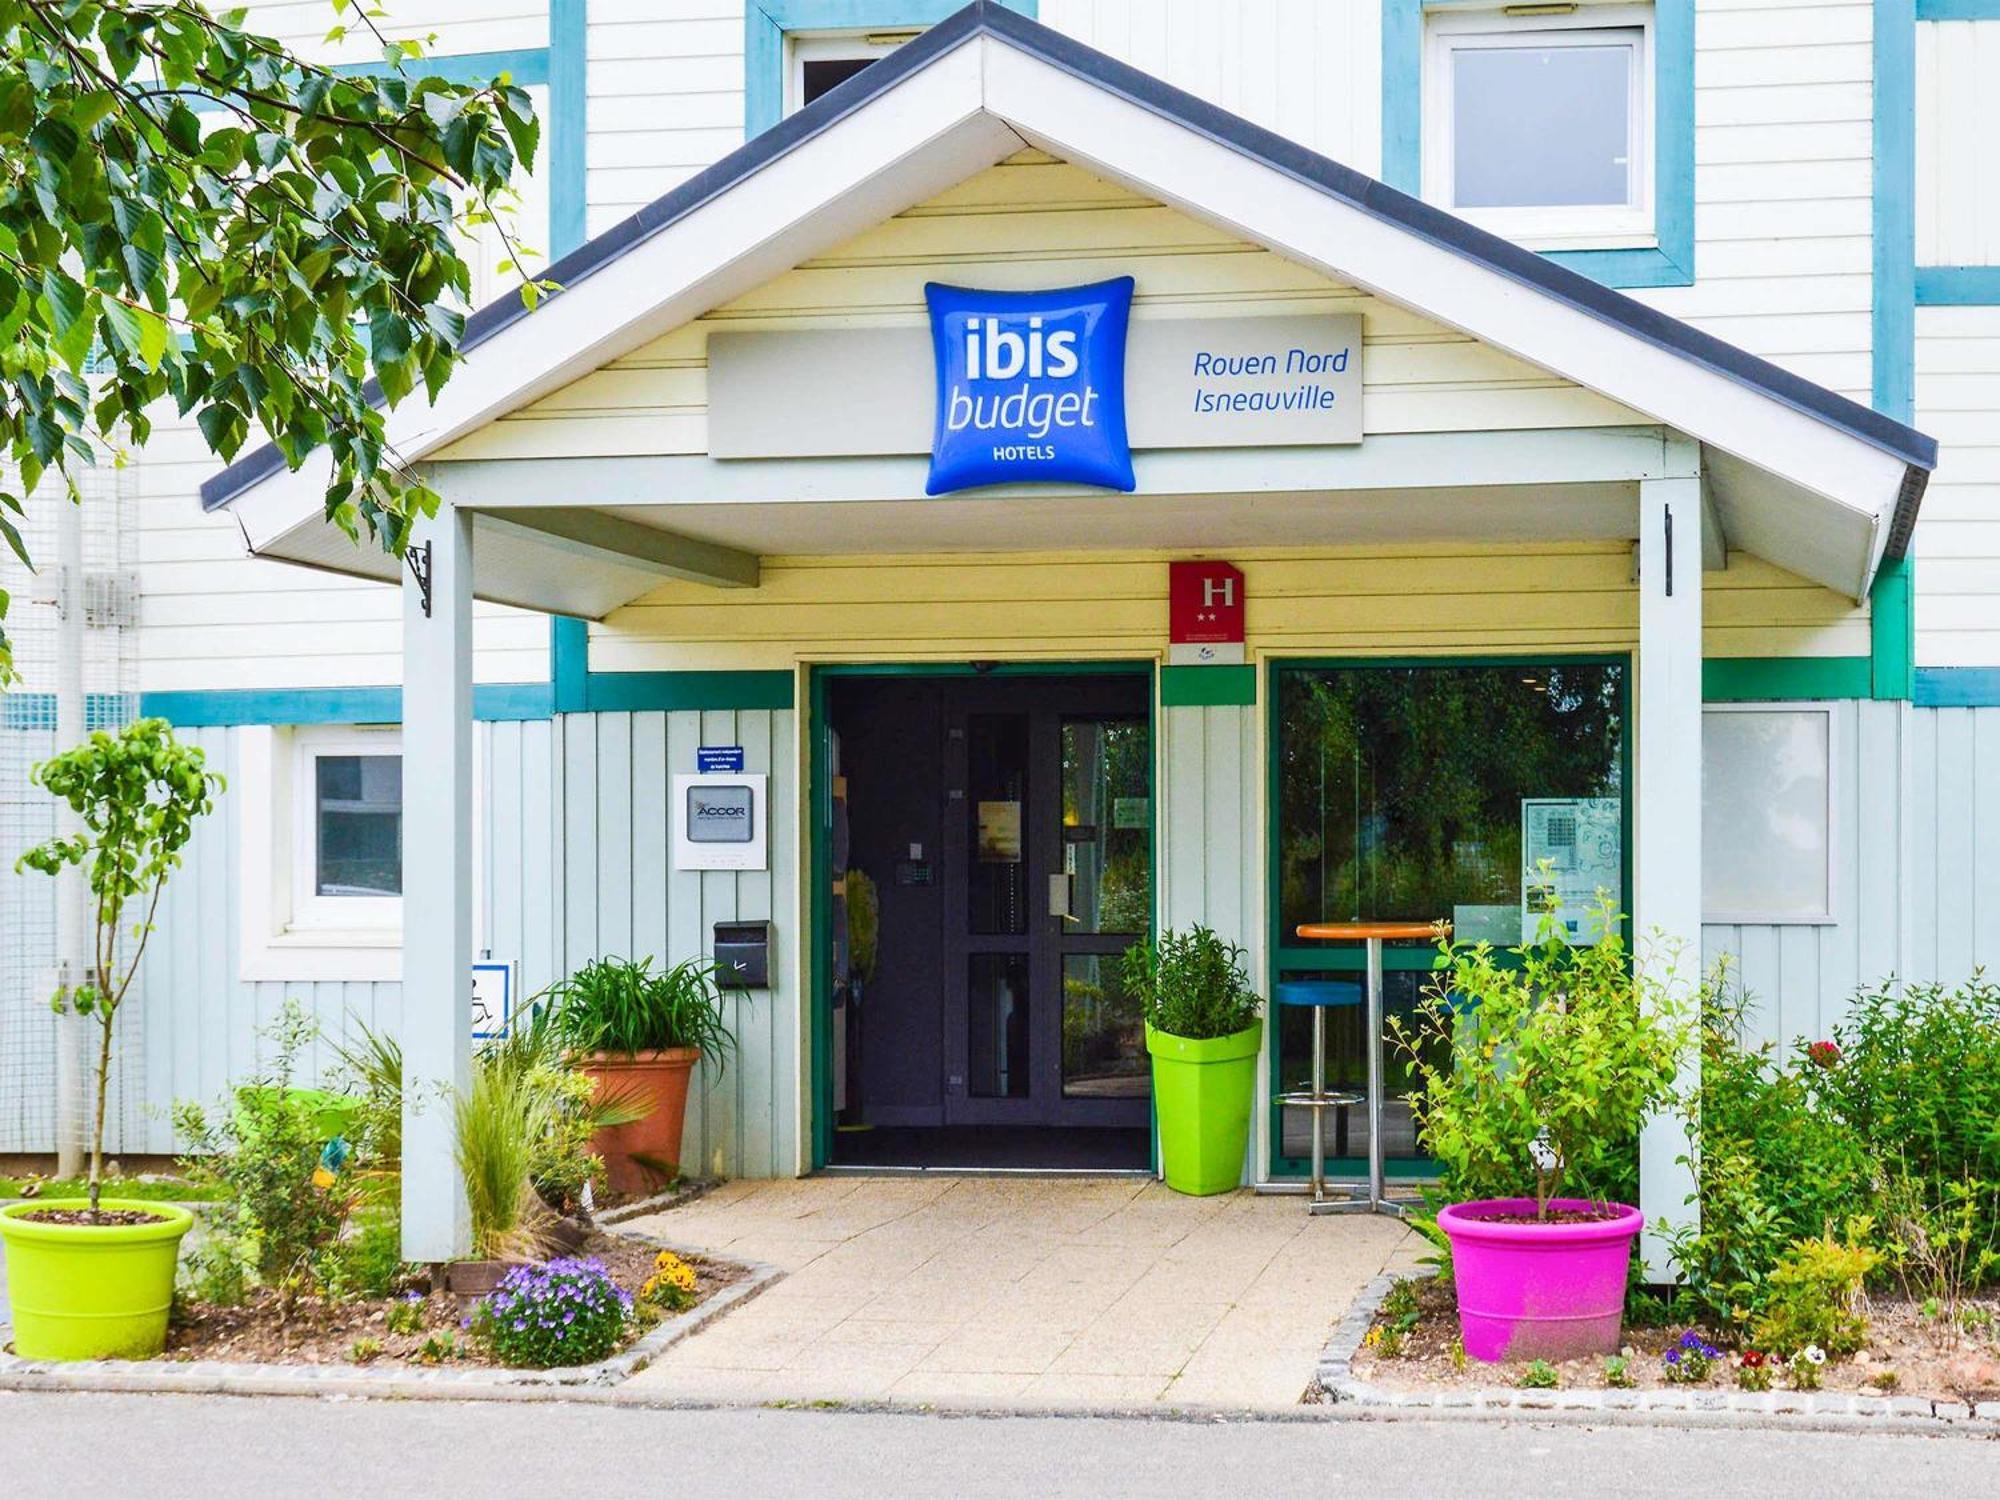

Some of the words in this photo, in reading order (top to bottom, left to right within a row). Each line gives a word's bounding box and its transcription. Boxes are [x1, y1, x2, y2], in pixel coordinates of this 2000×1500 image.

[966, 316, 1078, 379] ibis
[1194, 352, 1277, 376] Rouen
[1286, 348, 1349, 373] Nord
[948, 383, 1098, 439] budget
[1194, 385, 1335, 412] Isneauville
[993, 446, 1055, 461] HOTELS
[1204, 578, 1233, 607] H
[697, 807, 745, 816] ACCOR
